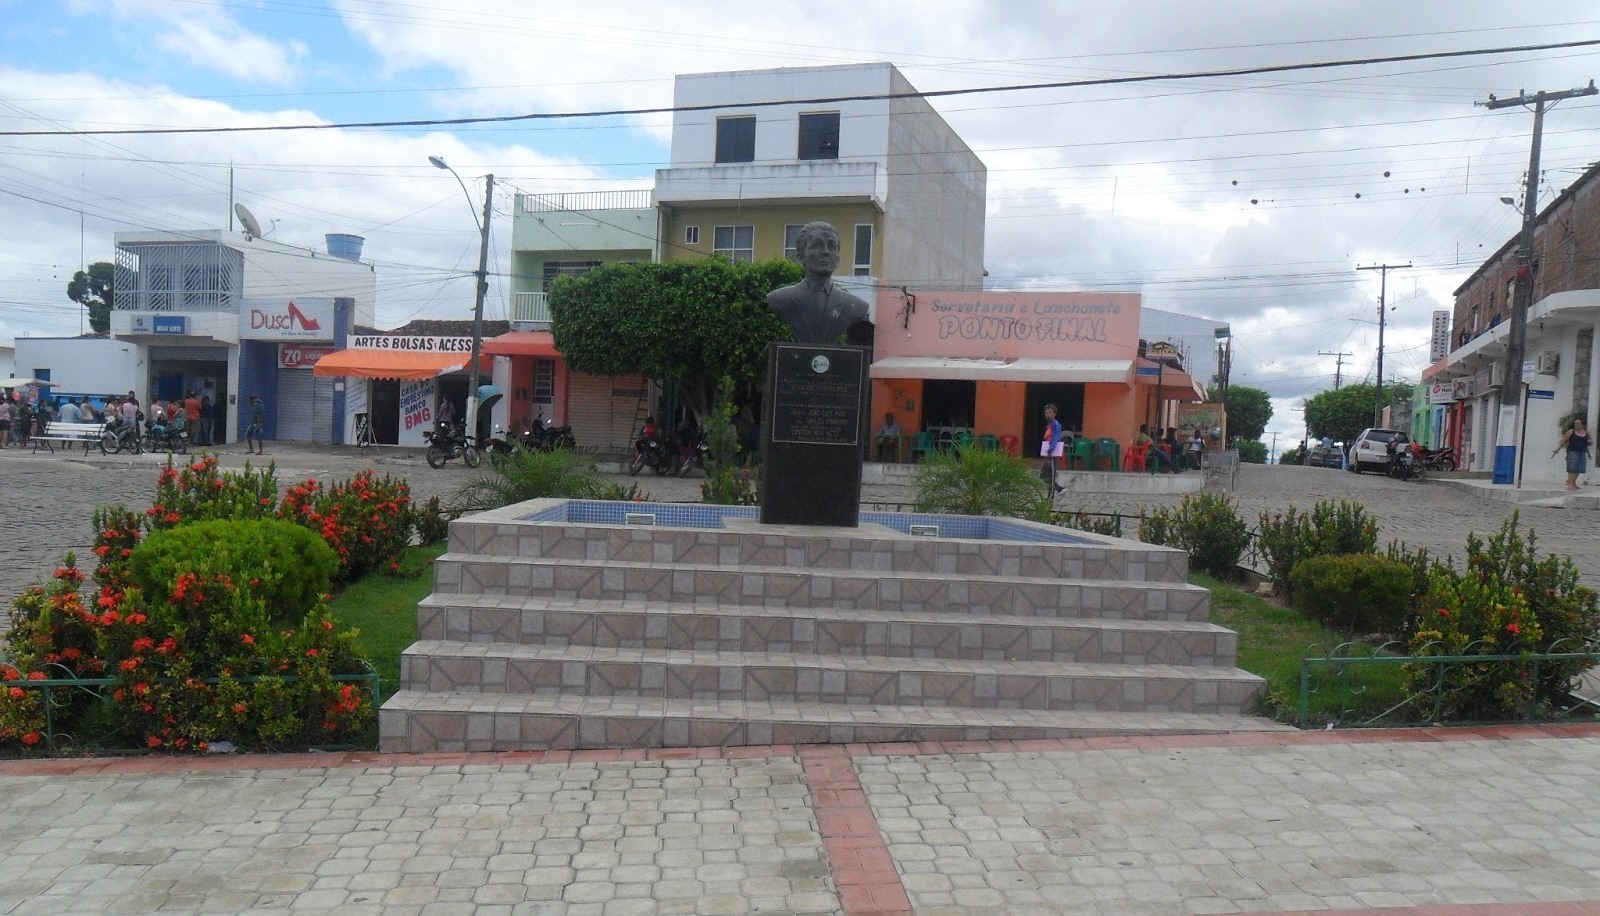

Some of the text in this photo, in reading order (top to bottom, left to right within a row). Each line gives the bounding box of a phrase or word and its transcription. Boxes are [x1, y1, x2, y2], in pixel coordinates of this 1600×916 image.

[1033, 301, 1121, 315] Lanchonete
[939, 315, 1107, 342] PONTO FINAL
[354, 337, 389, 348] ARTES
[391, 337, 433, 350] BOLSAS
[438, 338, 472, 352] ACESS
[284, 349, 301, 362] 70
[401, 383, 417, 396] CASA
[405, 399, 426, 415] BANCO
[405, 407, 431, 430] BMG
